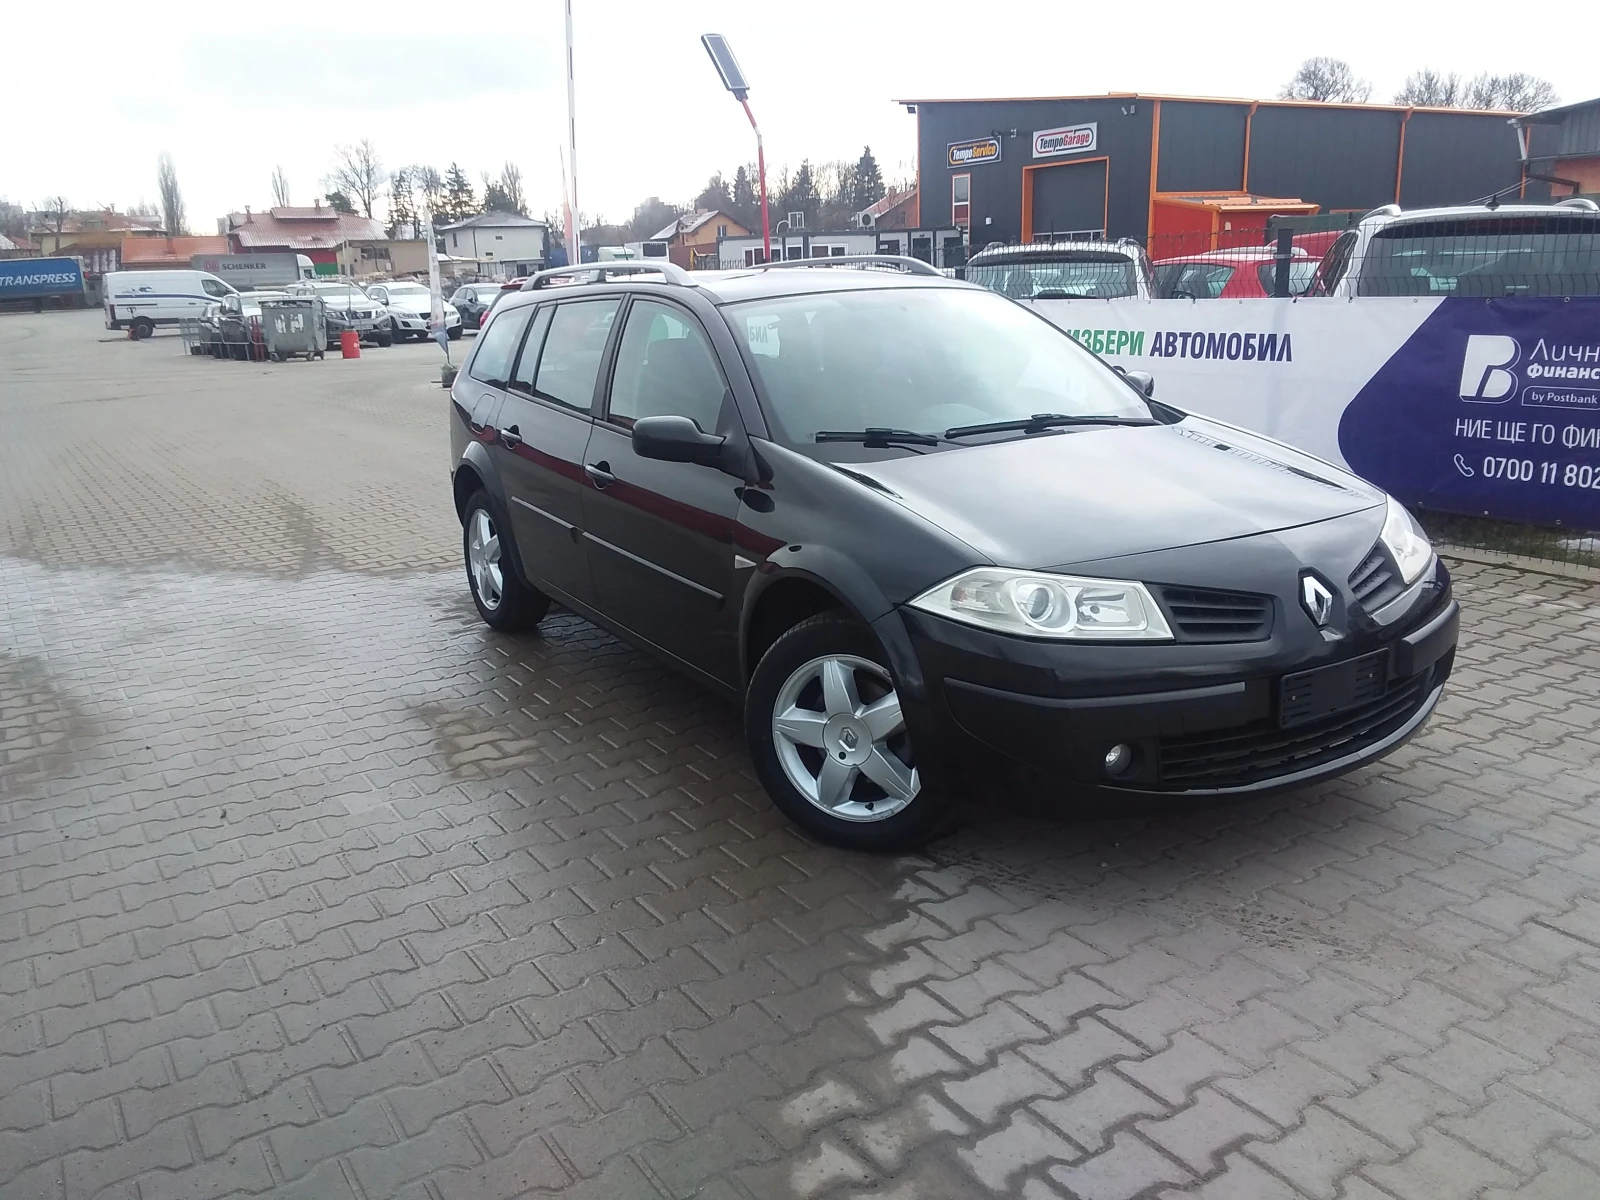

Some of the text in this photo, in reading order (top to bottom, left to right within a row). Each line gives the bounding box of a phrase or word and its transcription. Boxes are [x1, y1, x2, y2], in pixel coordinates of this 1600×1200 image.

[1039, 132, 1090, 151] TempoGarage
[952, 144, 996, 162] TempoService
[221, 262, 267, 271] SCHENKER
[1149, 331, 1293, 362] АВТОМОБИЛ
[1531, 392, 1598, 405] by Postbank
[1455, 418, 1493, 439] НИЕ
[1497, 420, 1527, 444] ЩЕ
[1531, 423, 1556, 445] ГО
[1483, 456, 1534, 482] 0700
[1541, 461, 1558, 485] 11
